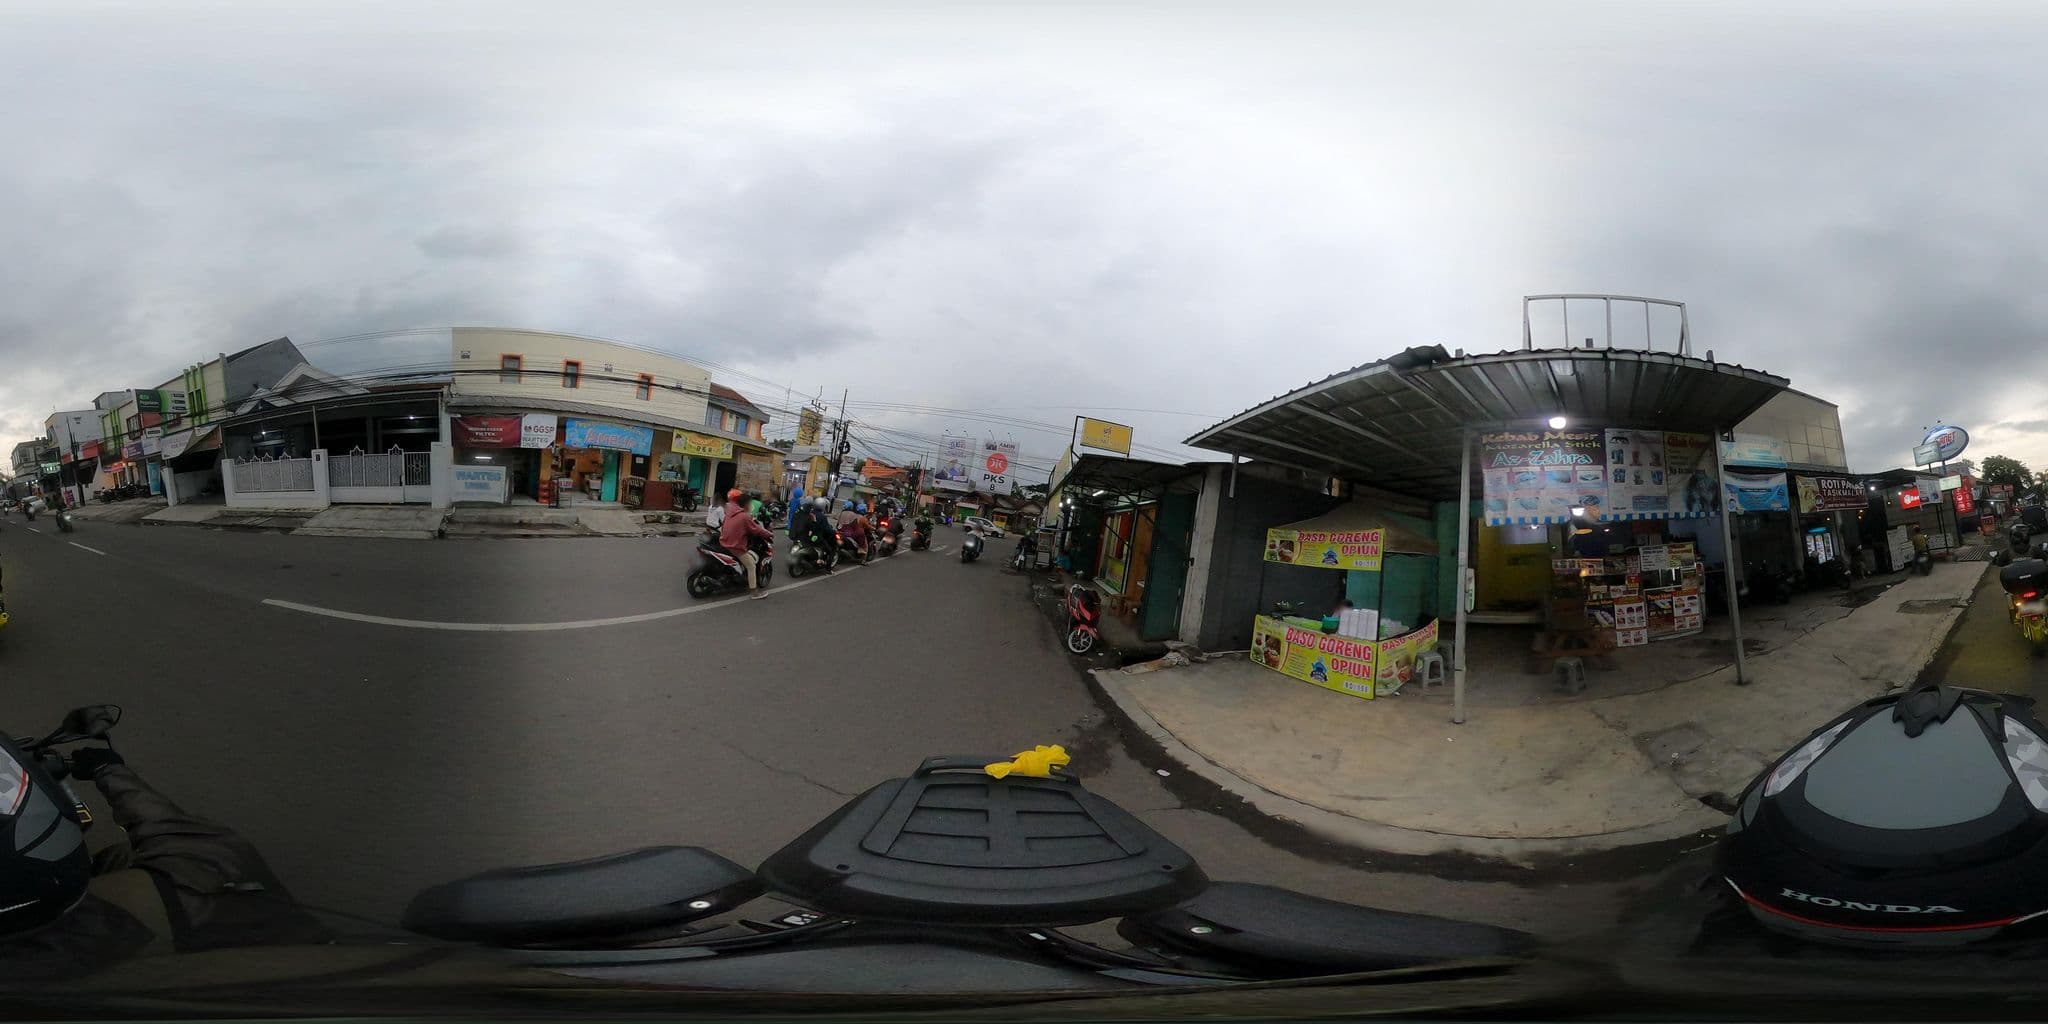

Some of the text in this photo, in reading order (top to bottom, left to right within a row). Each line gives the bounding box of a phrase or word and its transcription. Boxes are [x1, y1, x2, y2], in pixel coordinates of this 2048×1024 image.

[533, 425, 555, 434] GGSP
[1482, 431, 1599, 443] Kebab Mesir
[1485, 440, 1601, 452] Mozarella Stick
[1491, 449, 1593, 468] Az-Zahra
[983, 473, 1005, 484] PKS
[1821, 479, 1840, 489] ROTI
[989, 483, 996, 491] 8
[1329, 531, 1380, 544] GORENG
[1286, 627, 1316, 649] BASO
[1318, 635, 1373, 661] GORENG
[1331, 657, 1372, 679] OPIUN
[1781, 887, 1966, 914] HONDA
